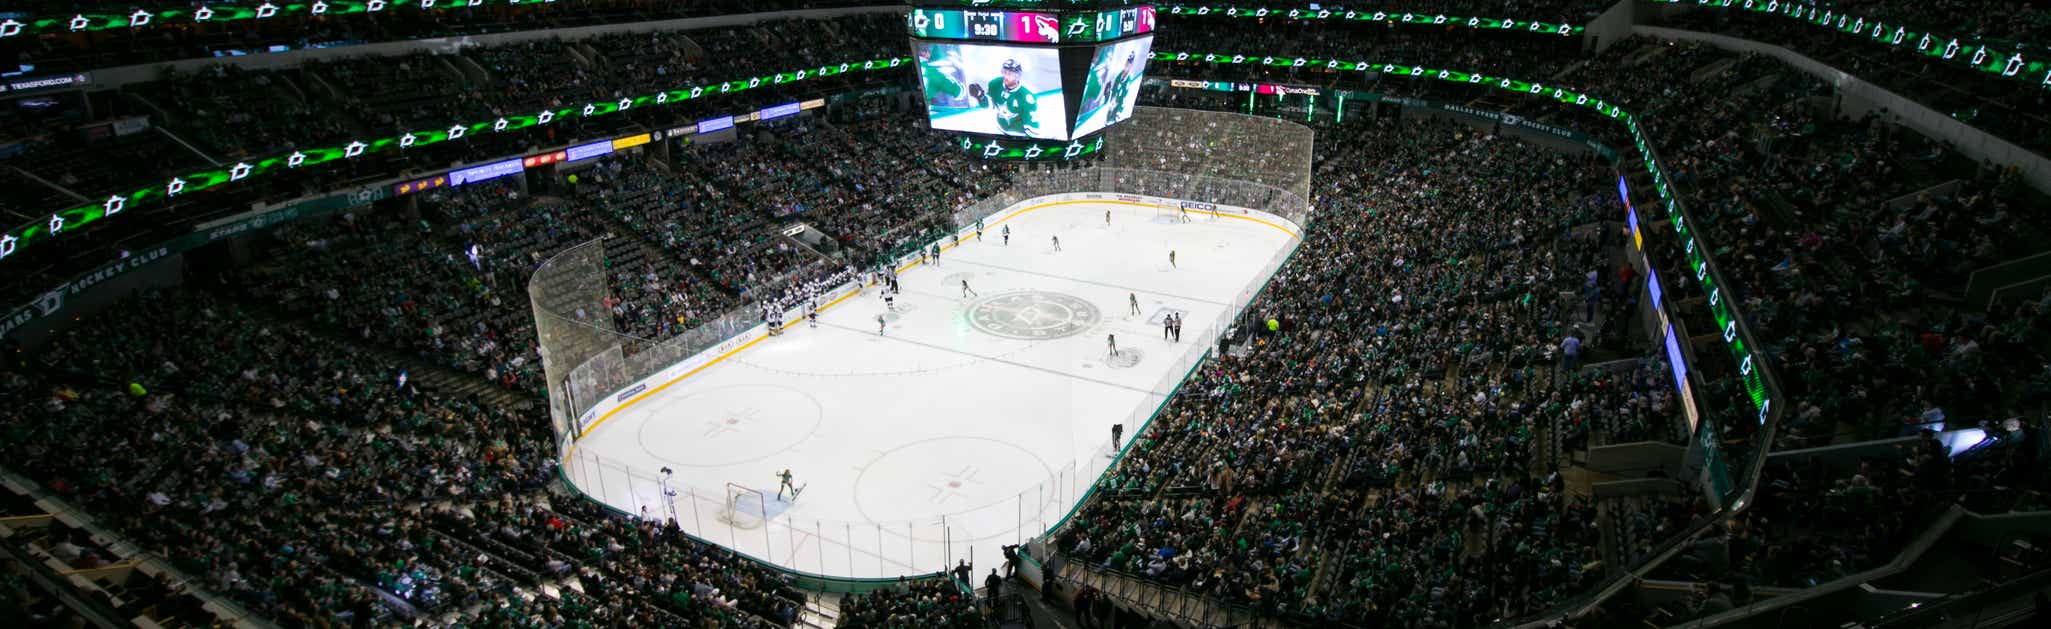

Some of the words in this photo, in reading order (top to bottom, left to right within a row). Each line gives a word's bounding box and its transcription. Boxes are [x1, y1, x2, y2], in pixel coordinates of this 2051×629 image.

[934, 13, 944, 30] 0
[1021, 16, 1031, 34] 1
[974, 24, 998, 36] 9:30
[11, 77, 73, 90] TEXASFORD.COM
[1180, 201, 1213, 212] GEICO
[70, 261, 126, 296] HOCKEY
[129, 247, 168, 269] CLUB
